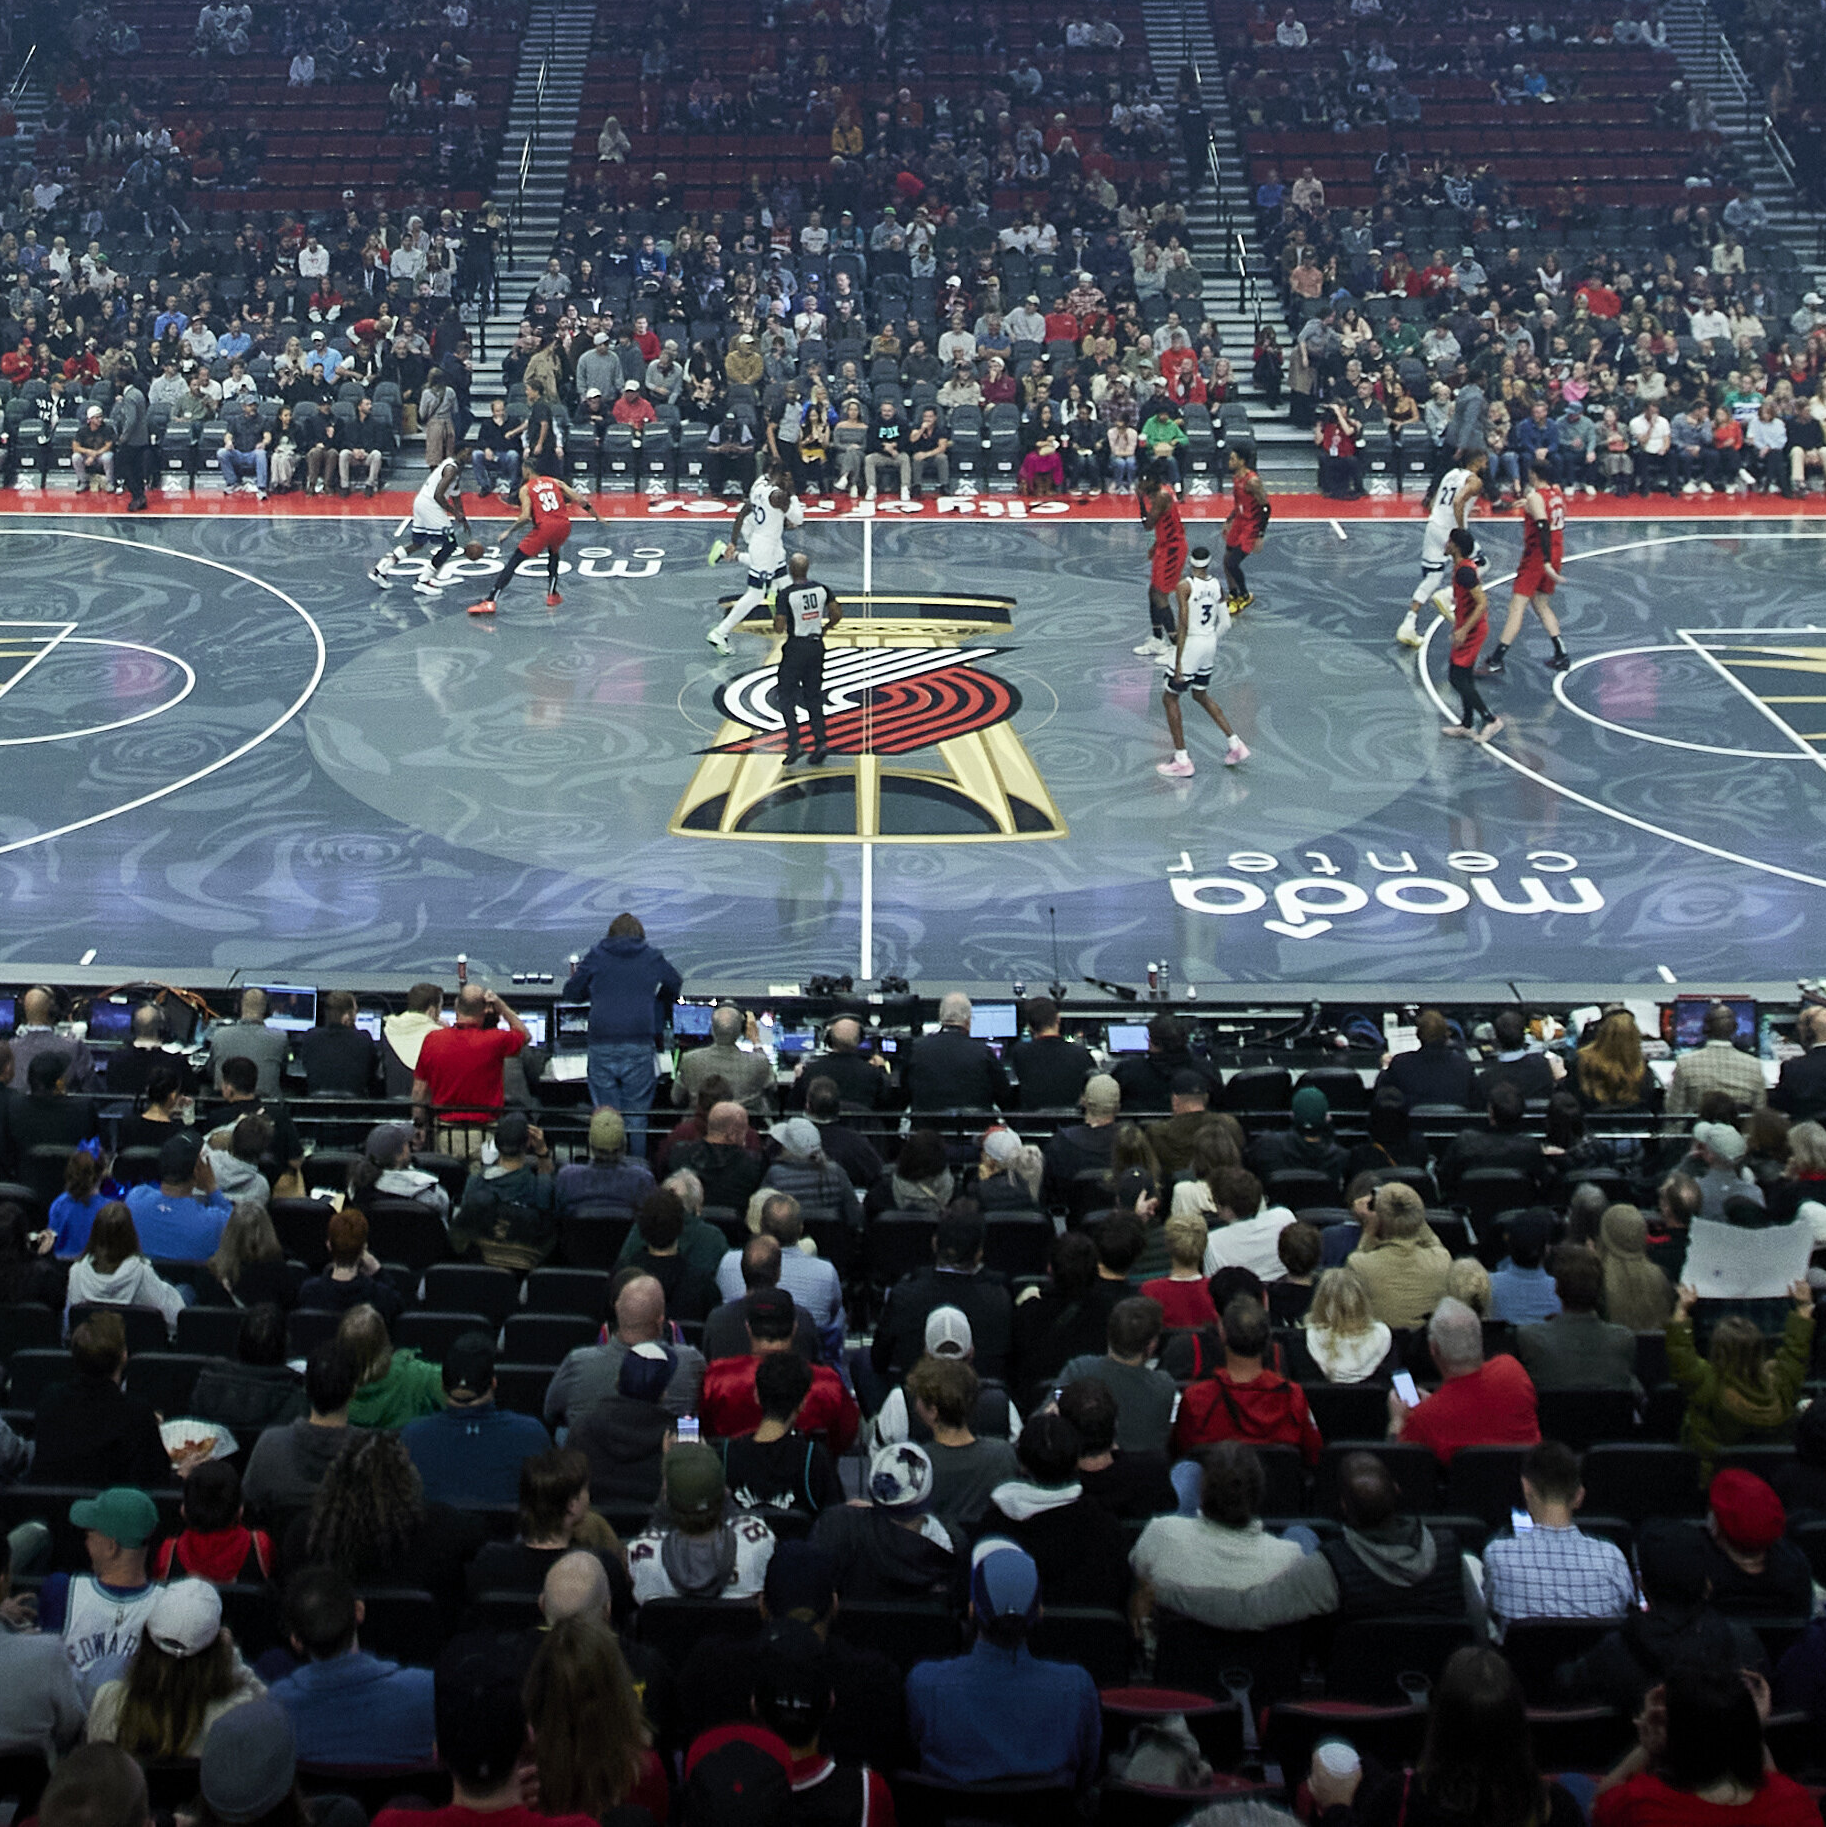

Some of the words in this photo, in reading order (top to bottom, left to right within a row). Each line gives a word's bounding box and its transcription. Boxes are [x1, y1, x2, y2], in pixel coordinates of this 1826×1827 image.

[538, 491, 560, 513] 33
[1440, 487, 1458, 505] 27
[802, 593, 818, 611] 30
[1200, 604, 1213, 625] 3
[1167, 851, 1578, 875] center
[1170, 877, 1605, 926] moda
